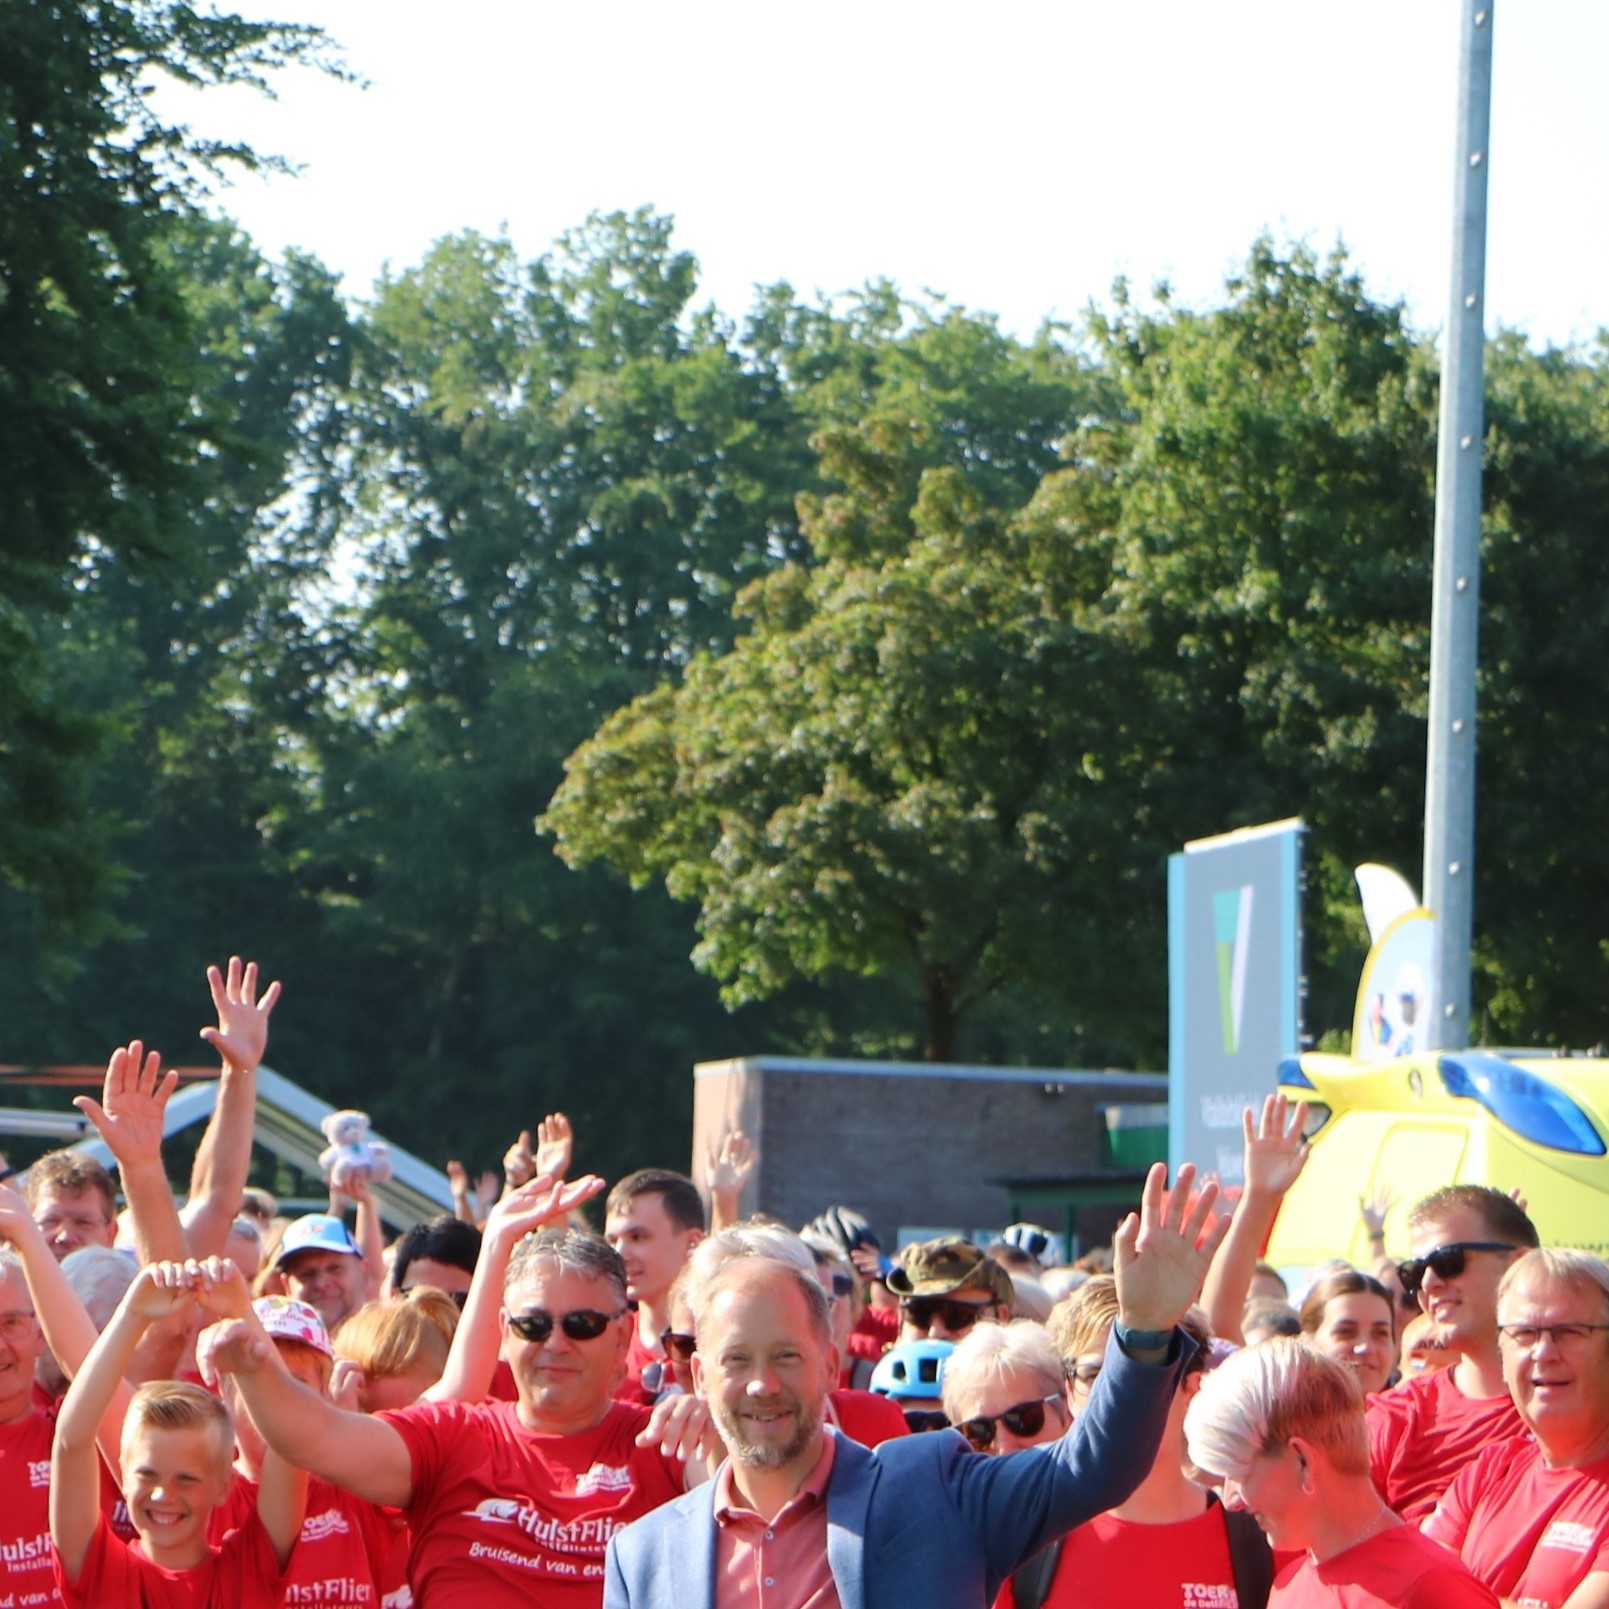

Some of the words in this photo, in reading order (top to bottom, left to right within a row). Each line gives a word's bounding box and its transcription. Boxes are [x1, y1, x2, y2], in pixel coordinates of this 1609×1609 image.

[518, 1505, 629, 1543] HulstFlie
[7, 1557, 53, 1572] Installa
[469, 1542, 542, 1569] Bruisend
[546, 1559, 577, 1576] van
[19, 1592, 48, 1606] van
[1181, 1583, 1230, 1600] TOER
